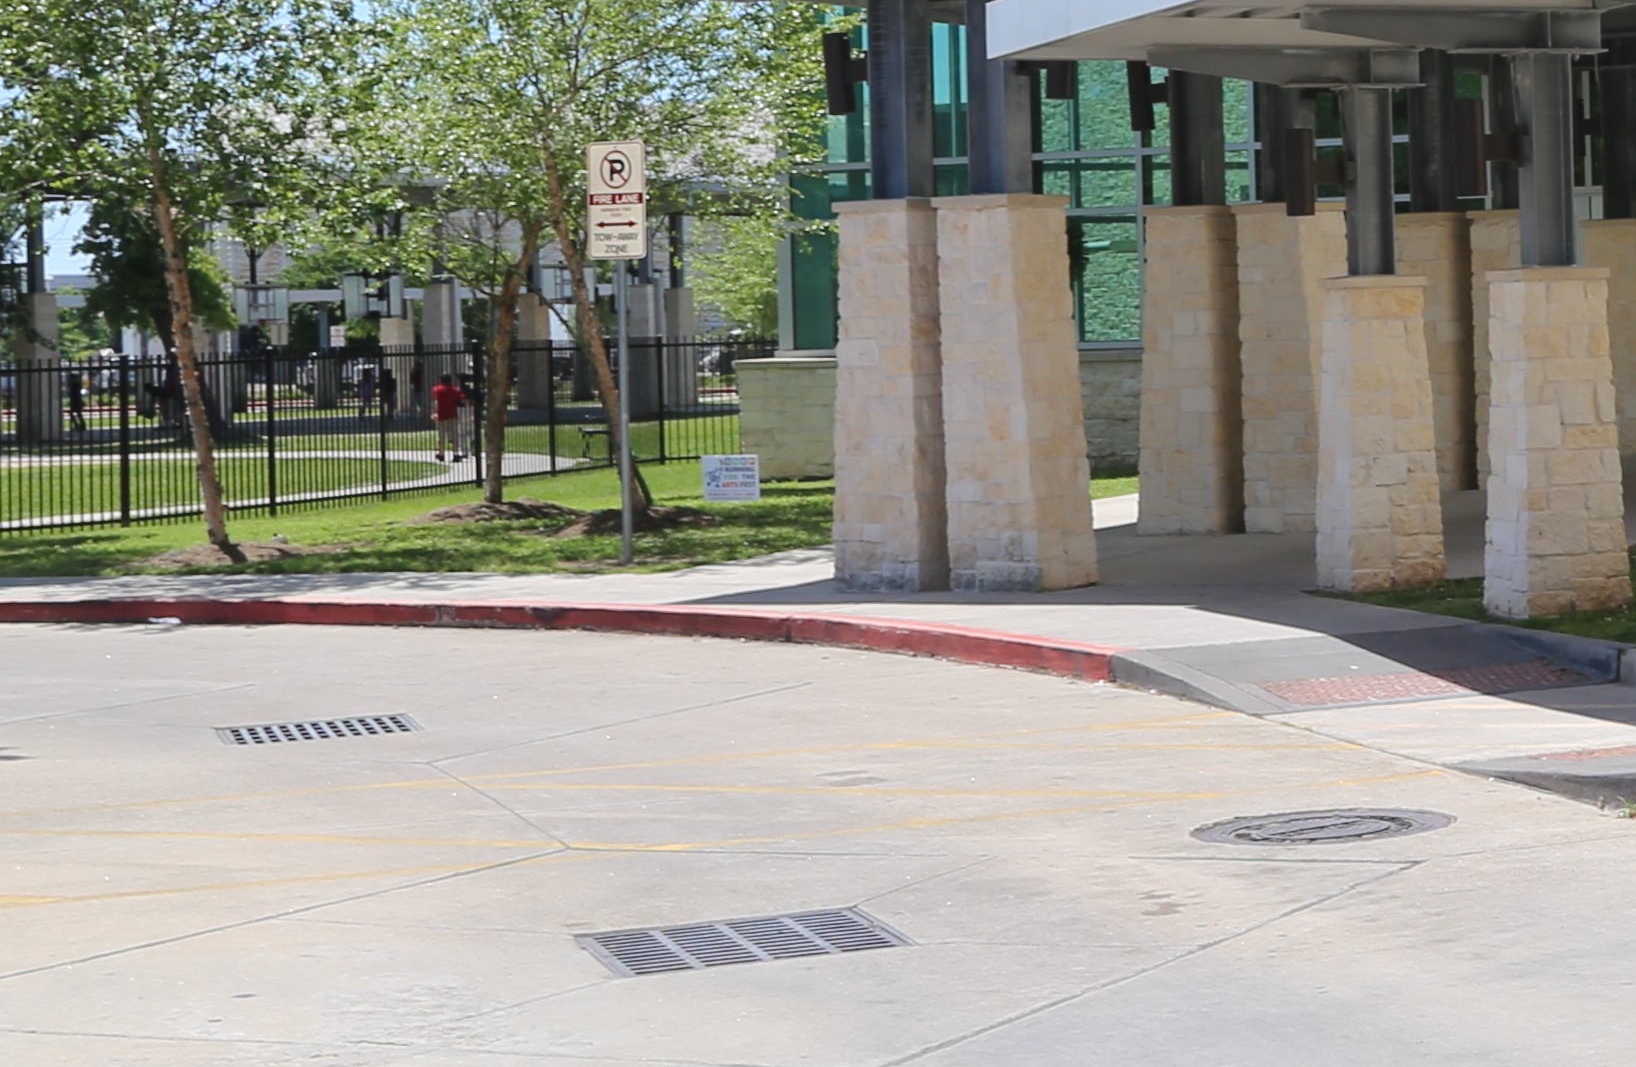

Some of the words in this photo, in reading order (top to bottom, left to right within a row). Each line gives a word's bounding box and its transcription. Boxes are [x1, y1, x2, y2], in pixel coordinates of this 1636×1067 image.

[593, 195, 613, 204] FIRE
[615, 194, 640, 203] LANE
[593, 232, 639, 242] TOW-AWAY
[605, 244, 629, 254] ZONE
